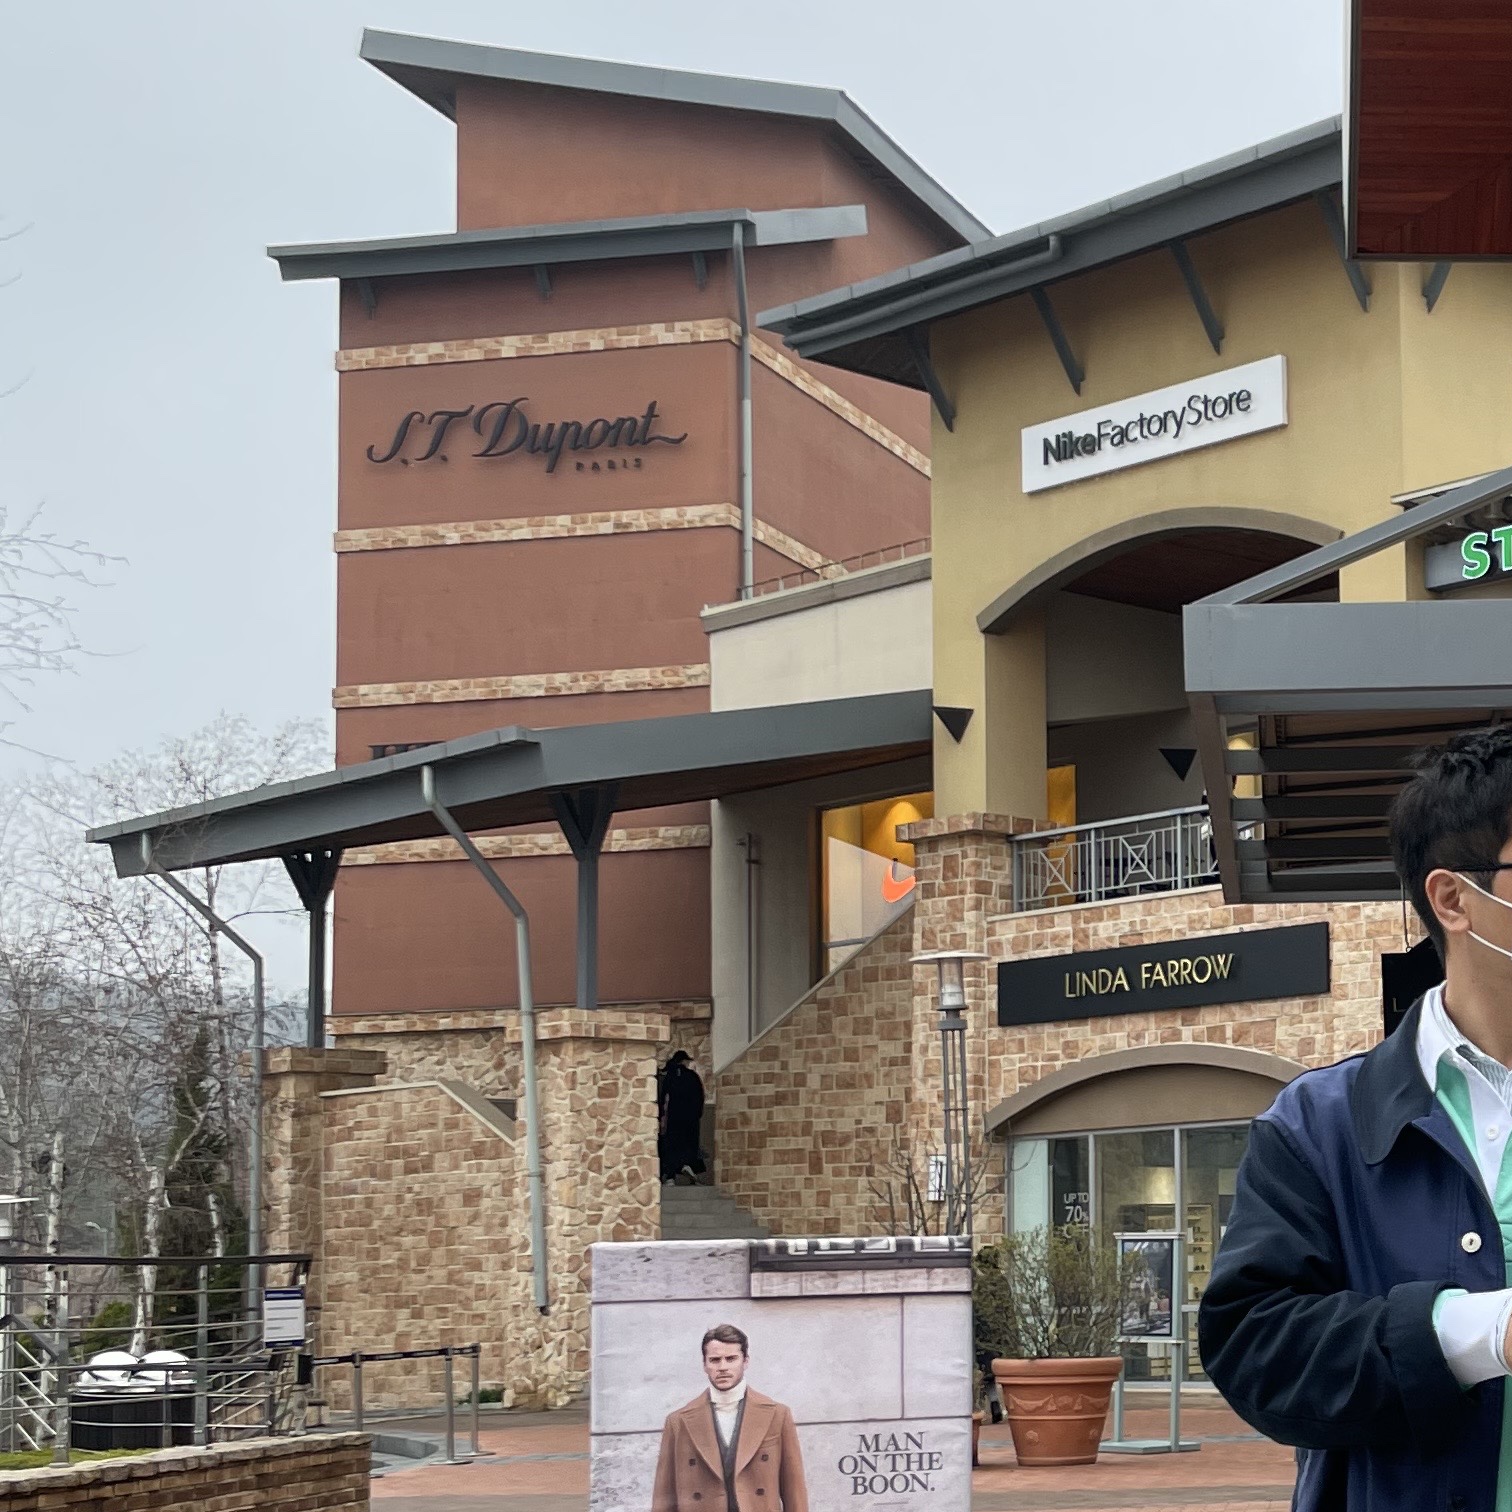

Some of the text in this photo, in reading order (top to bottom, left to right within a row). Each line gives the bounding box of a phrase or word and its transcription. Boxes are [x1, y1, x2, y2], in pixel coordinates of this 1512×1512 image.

[471, 397, 689, 474] Dupont
[1064, 952, 1235, 998] LINDA FARROW
[1063, 1191, 1089, 1204] UP TO
[856, 1431, 926, 1453] MAN
[838, 1451, 944, 1475] ON THE
[851, 1472, 936, 1496] BOON.
